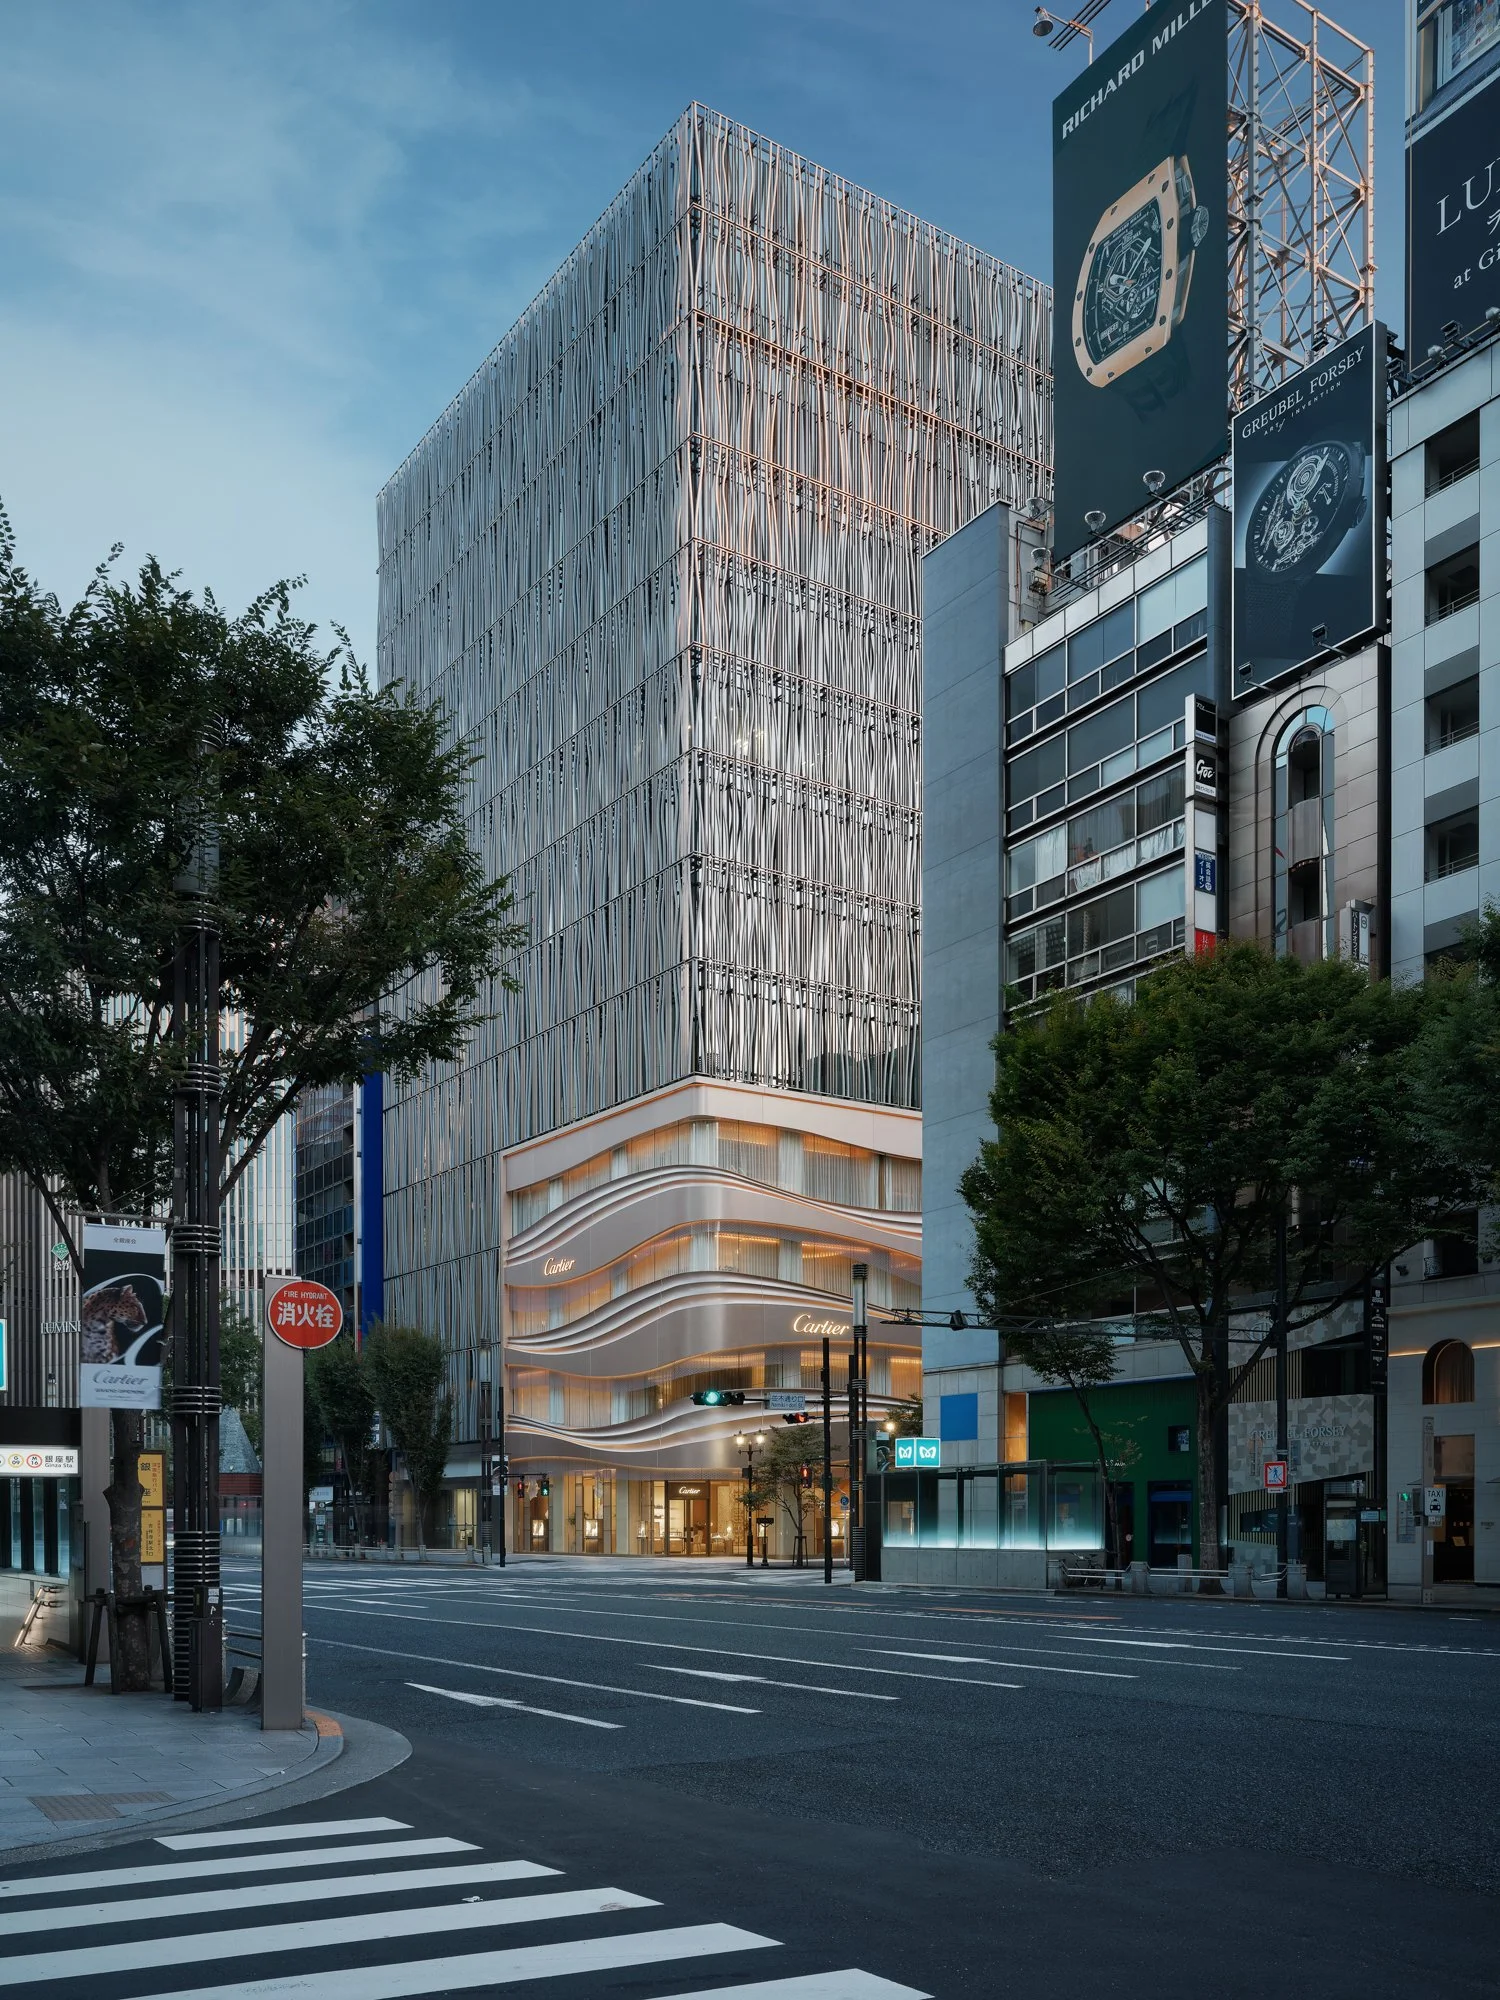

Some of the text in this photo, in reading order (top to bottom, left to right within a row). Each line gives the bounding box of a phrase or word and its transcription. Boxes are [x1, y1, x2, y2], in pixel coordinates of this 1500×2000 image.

[1062, 49, 1145, 140] RICHARD
[1437, 156, 1500, 236] LU
[1453, 267, 1472, 290] at
[1242, 345, 1365, 439] GREUBEL FORSEY
[1291, 381, 1341, 418] INVENTION
[54, 1260, 71, 1271] 松竹
[544, 1257, 575, 1276] Cartier
[283, 1290, 328, 1300] FIRE HYDRANT
[277, 1301, 335, 1328] 消火栓
[793, 1313, 850, 1335] Cartier
[93, 1369, 149, 1385] Cartier
[1305, 1425, 1346, 1439] FORSEY
[44, 1455, 74, 1463] 銀座駅
[678, 1486, 701, 1494] Cartier
